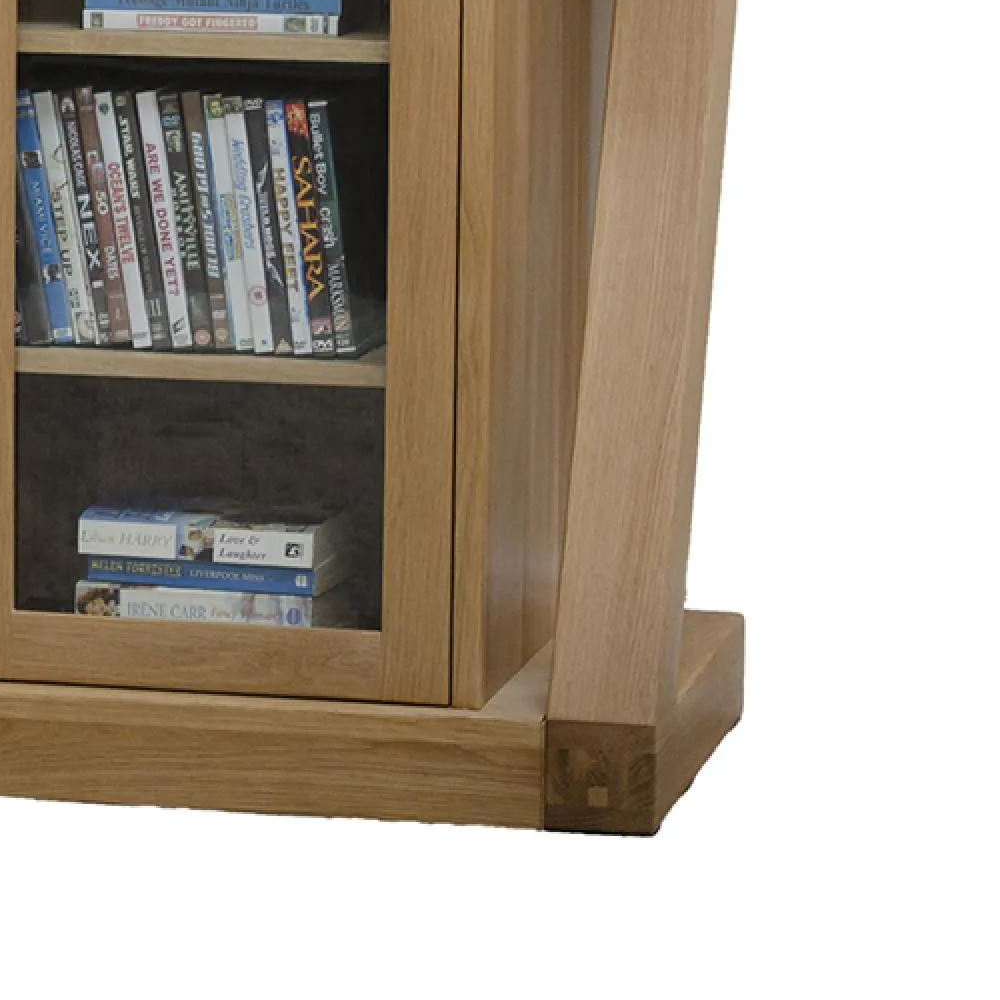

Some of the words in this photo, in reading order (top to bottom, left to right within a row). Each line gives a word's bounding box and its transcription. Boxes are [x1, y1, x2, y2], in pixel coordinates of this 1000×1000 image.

[309, 112, 325, 160] Bullet
[145, 142, 161, 174] ARE
[151, 177, 167, 203] WE
[315, 162, 328, 195] Boy
[273, 167, 292, 236] HAPPY
[155, 207, 173, 253] DONE
[292, 154, 325, 302] SAHARA
[60, 250, 73, 277] UP
[163, 256, 180, 297] YET?
[282, 241, 299, 292] FEET
[119, 530, 174, 547] HARRY
[218, 548, 267, 561] Laughter
[219, 533, 245, 545] Love
[127, 601, 166, 618] IRENE
[169, 603, 207, 620] CARR
